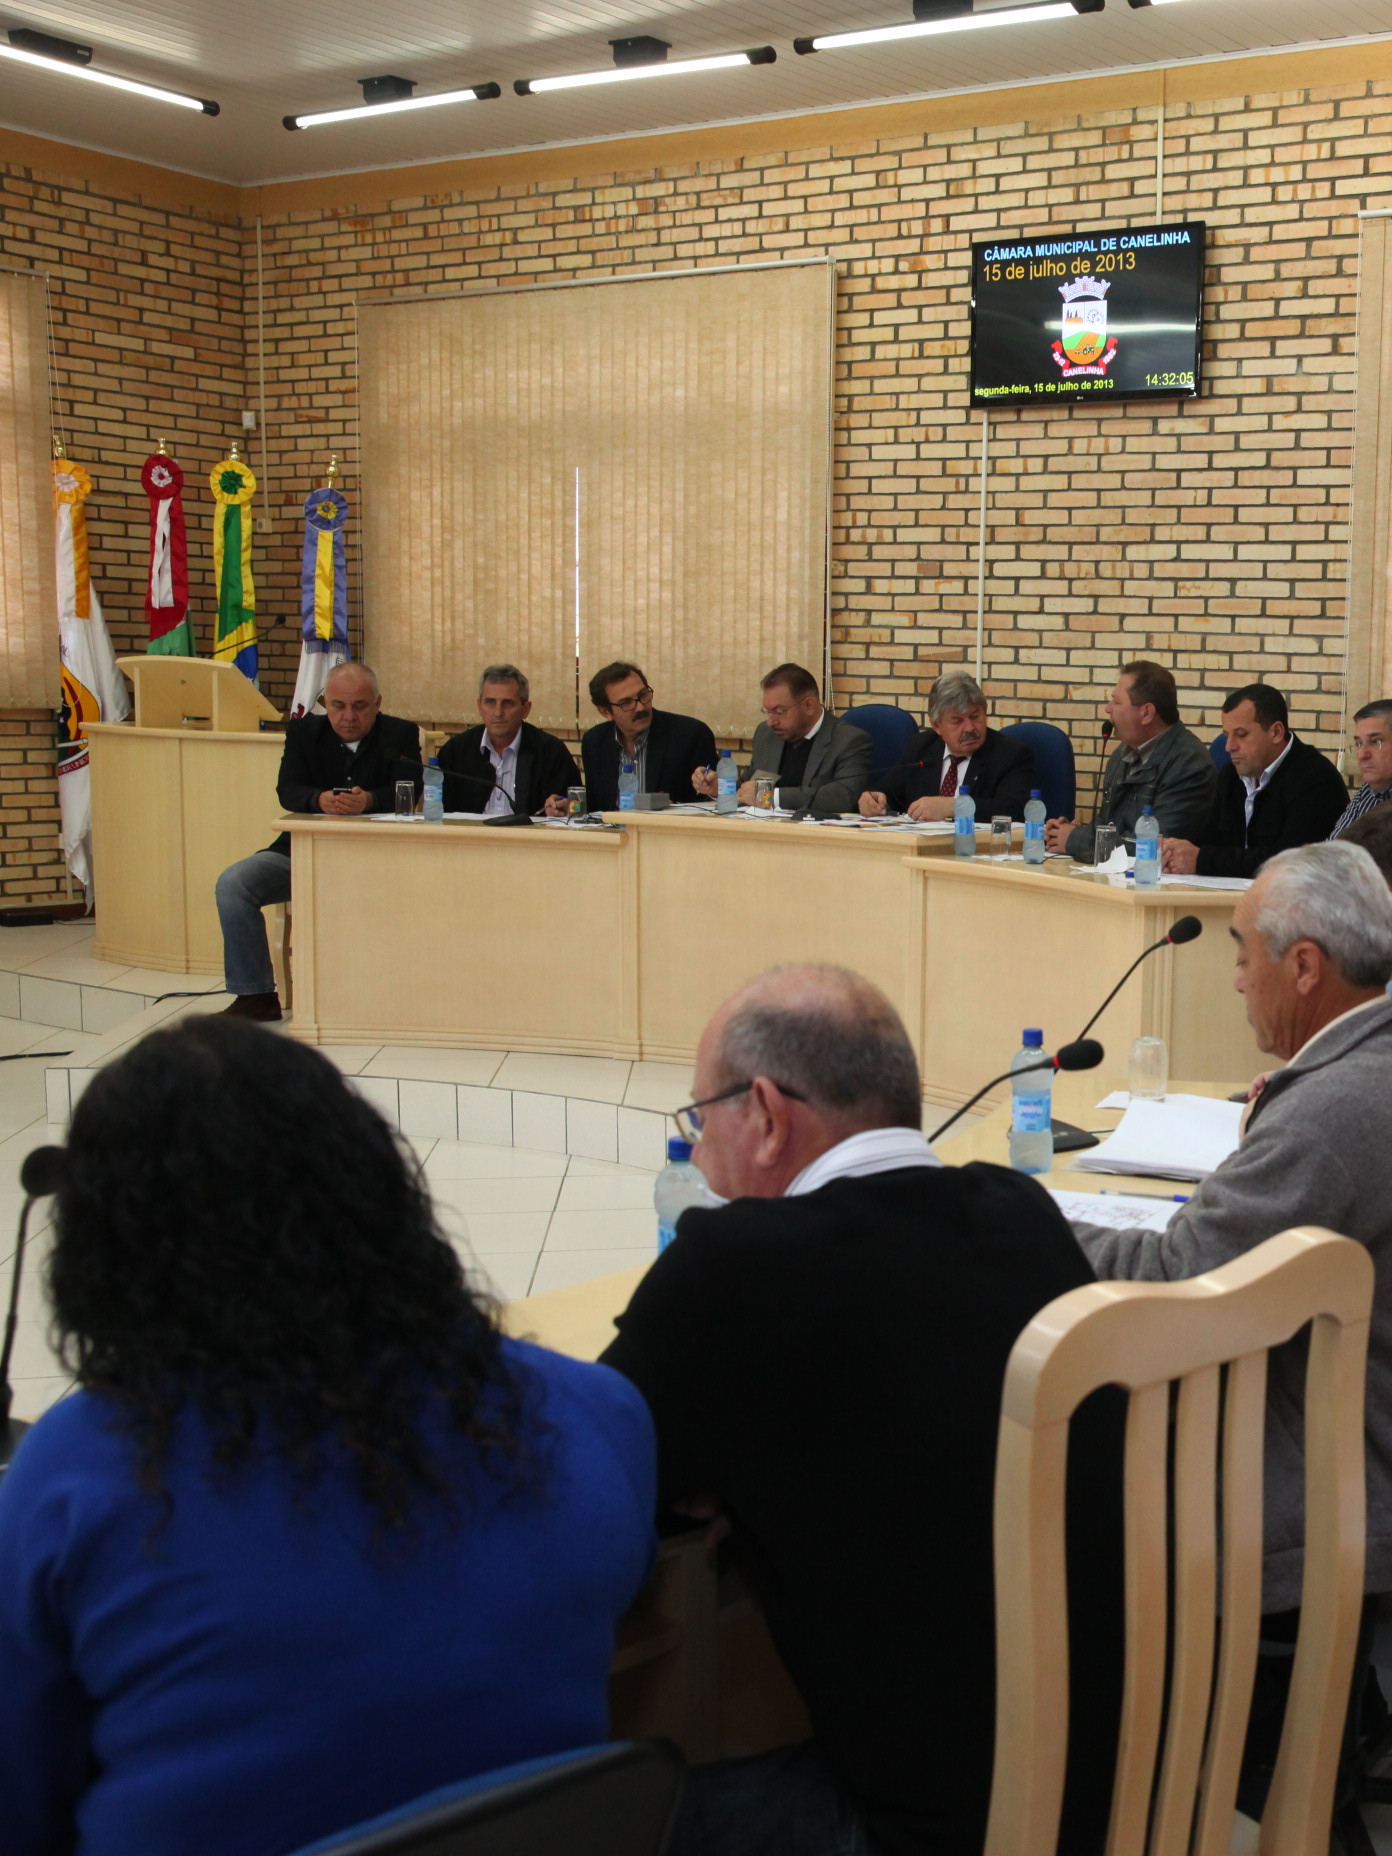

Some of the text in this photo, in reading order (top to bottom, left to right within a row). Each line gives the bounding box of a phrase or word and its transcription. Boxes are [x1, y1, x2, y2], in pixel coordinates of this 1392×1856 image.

[984, 231, 1191, 262] CÂMARA MUNICIPAL DE CANELINHA
[983, 251, 1136, 282] 15 de julho de 2013
[1063, 366, 1105, 377] CANELINHA
[1145, 372, 1194, 387] 14:32:05
[974, 378, 1114, 398] segunda-feira, 15 de julho de 2013
